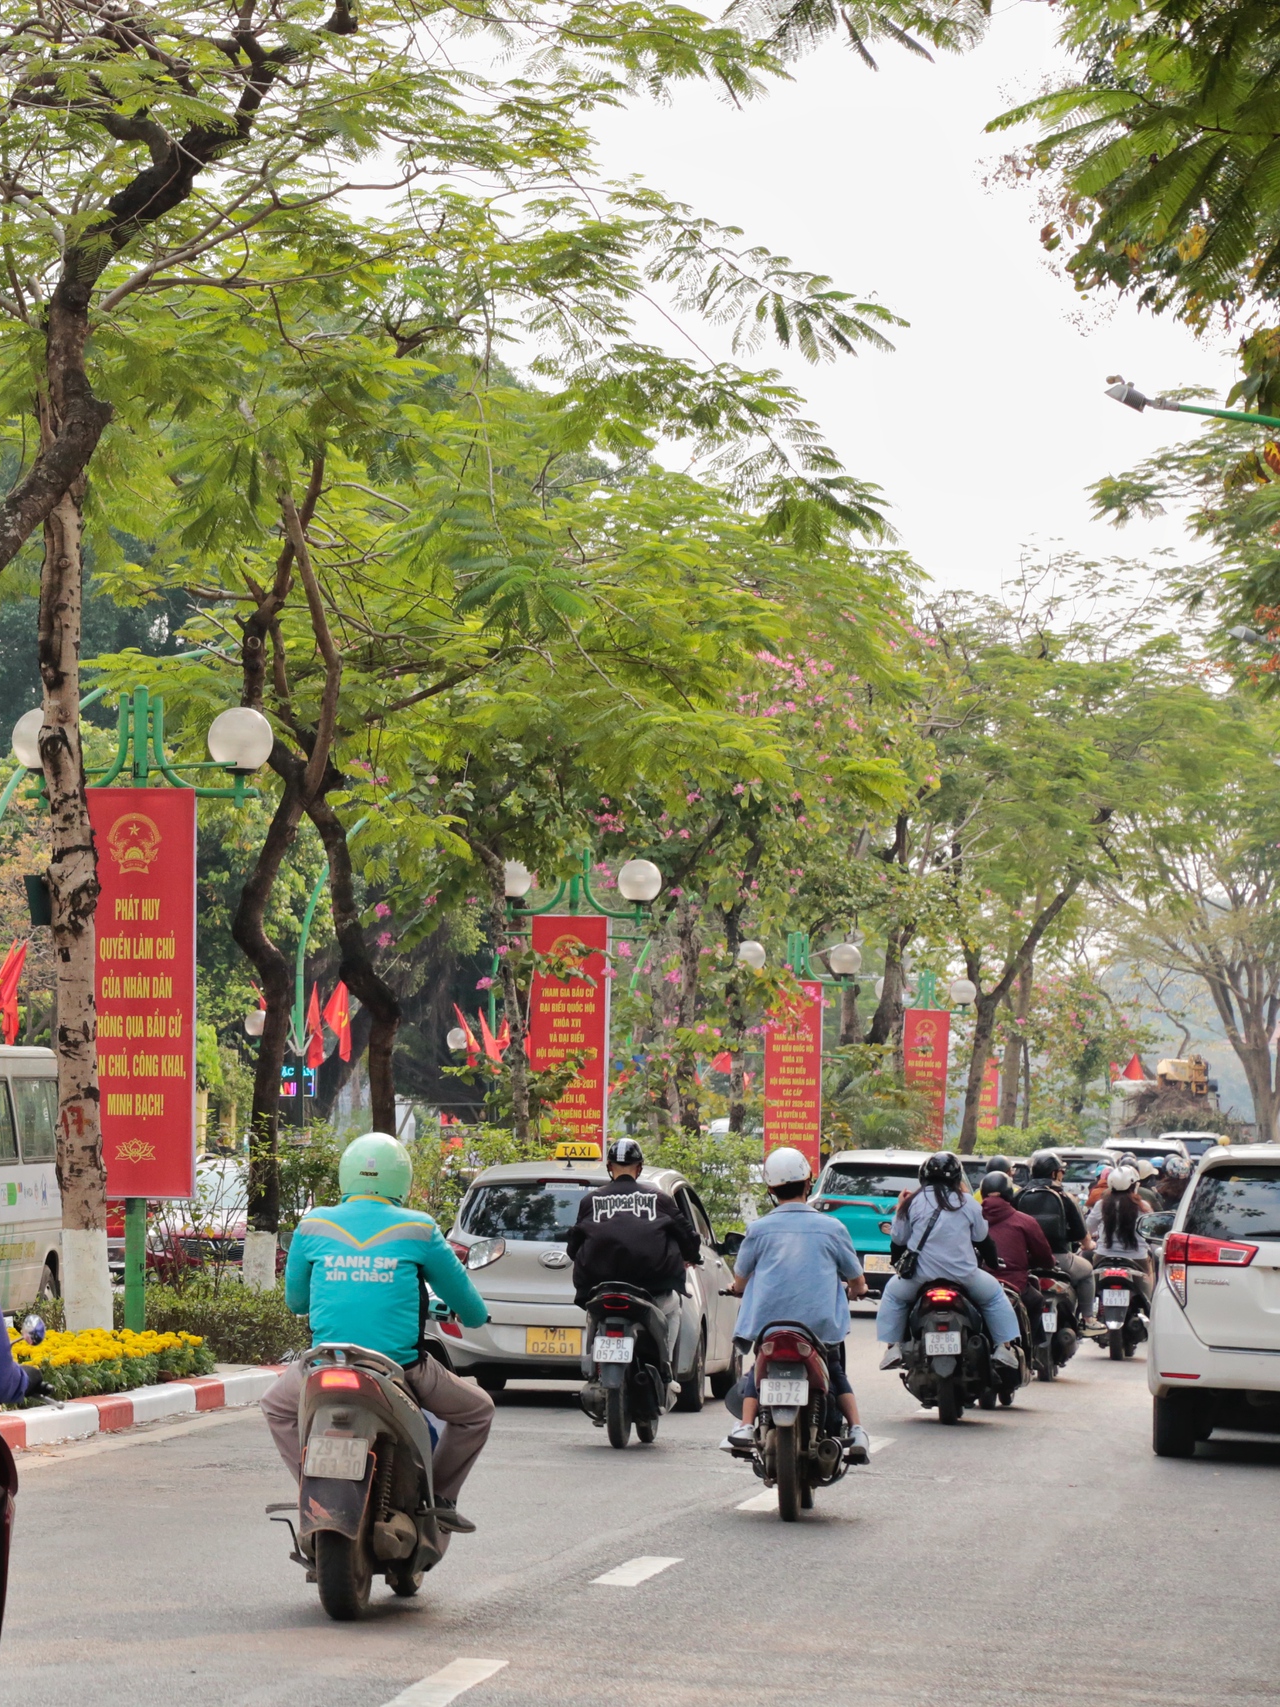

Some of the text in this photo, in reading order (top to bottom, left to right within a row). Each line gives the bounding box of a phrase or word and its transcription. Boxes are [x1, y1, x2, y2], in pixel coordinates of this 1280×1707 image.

[115, 893, 160, 920] PHÁT HUY
[99, 930, 176, 962] QUYỀN LÀM CHỦ
[101, 969, 172, 998] CỦA NHÂN DÂN
[126, 1016, 144, 1040] QUA
[147, 1008, 166, 1038] BẦU
[168, 1008, 182, 1038] CỬ
[108, 1048, 130, 1079] CHỦ,
[133, 1050, 159, 1077] CÔNG
[161, 1055, 186, 1079] KHAI,
[107, 1094, 164, 1121] MINH BẠCH!
[563, 1146, 591, 1156] TAXI
[324, 1256, 398, 1270] XANH SM
[325, 1268, 394, 1283] xin chào!
[544, 1329, 566, 1341] 17H
[532, 1342, 574, 1354] 026.01
[600, 1339, 626, 1350] 29-BL
[596, 1350, 630, 1361] 057.39
[768, 1381, 801, 1392] 98-Y2
[767, 1392, 800, 1404] 0074
[316, 1440, 358, 1457] 29-AC
